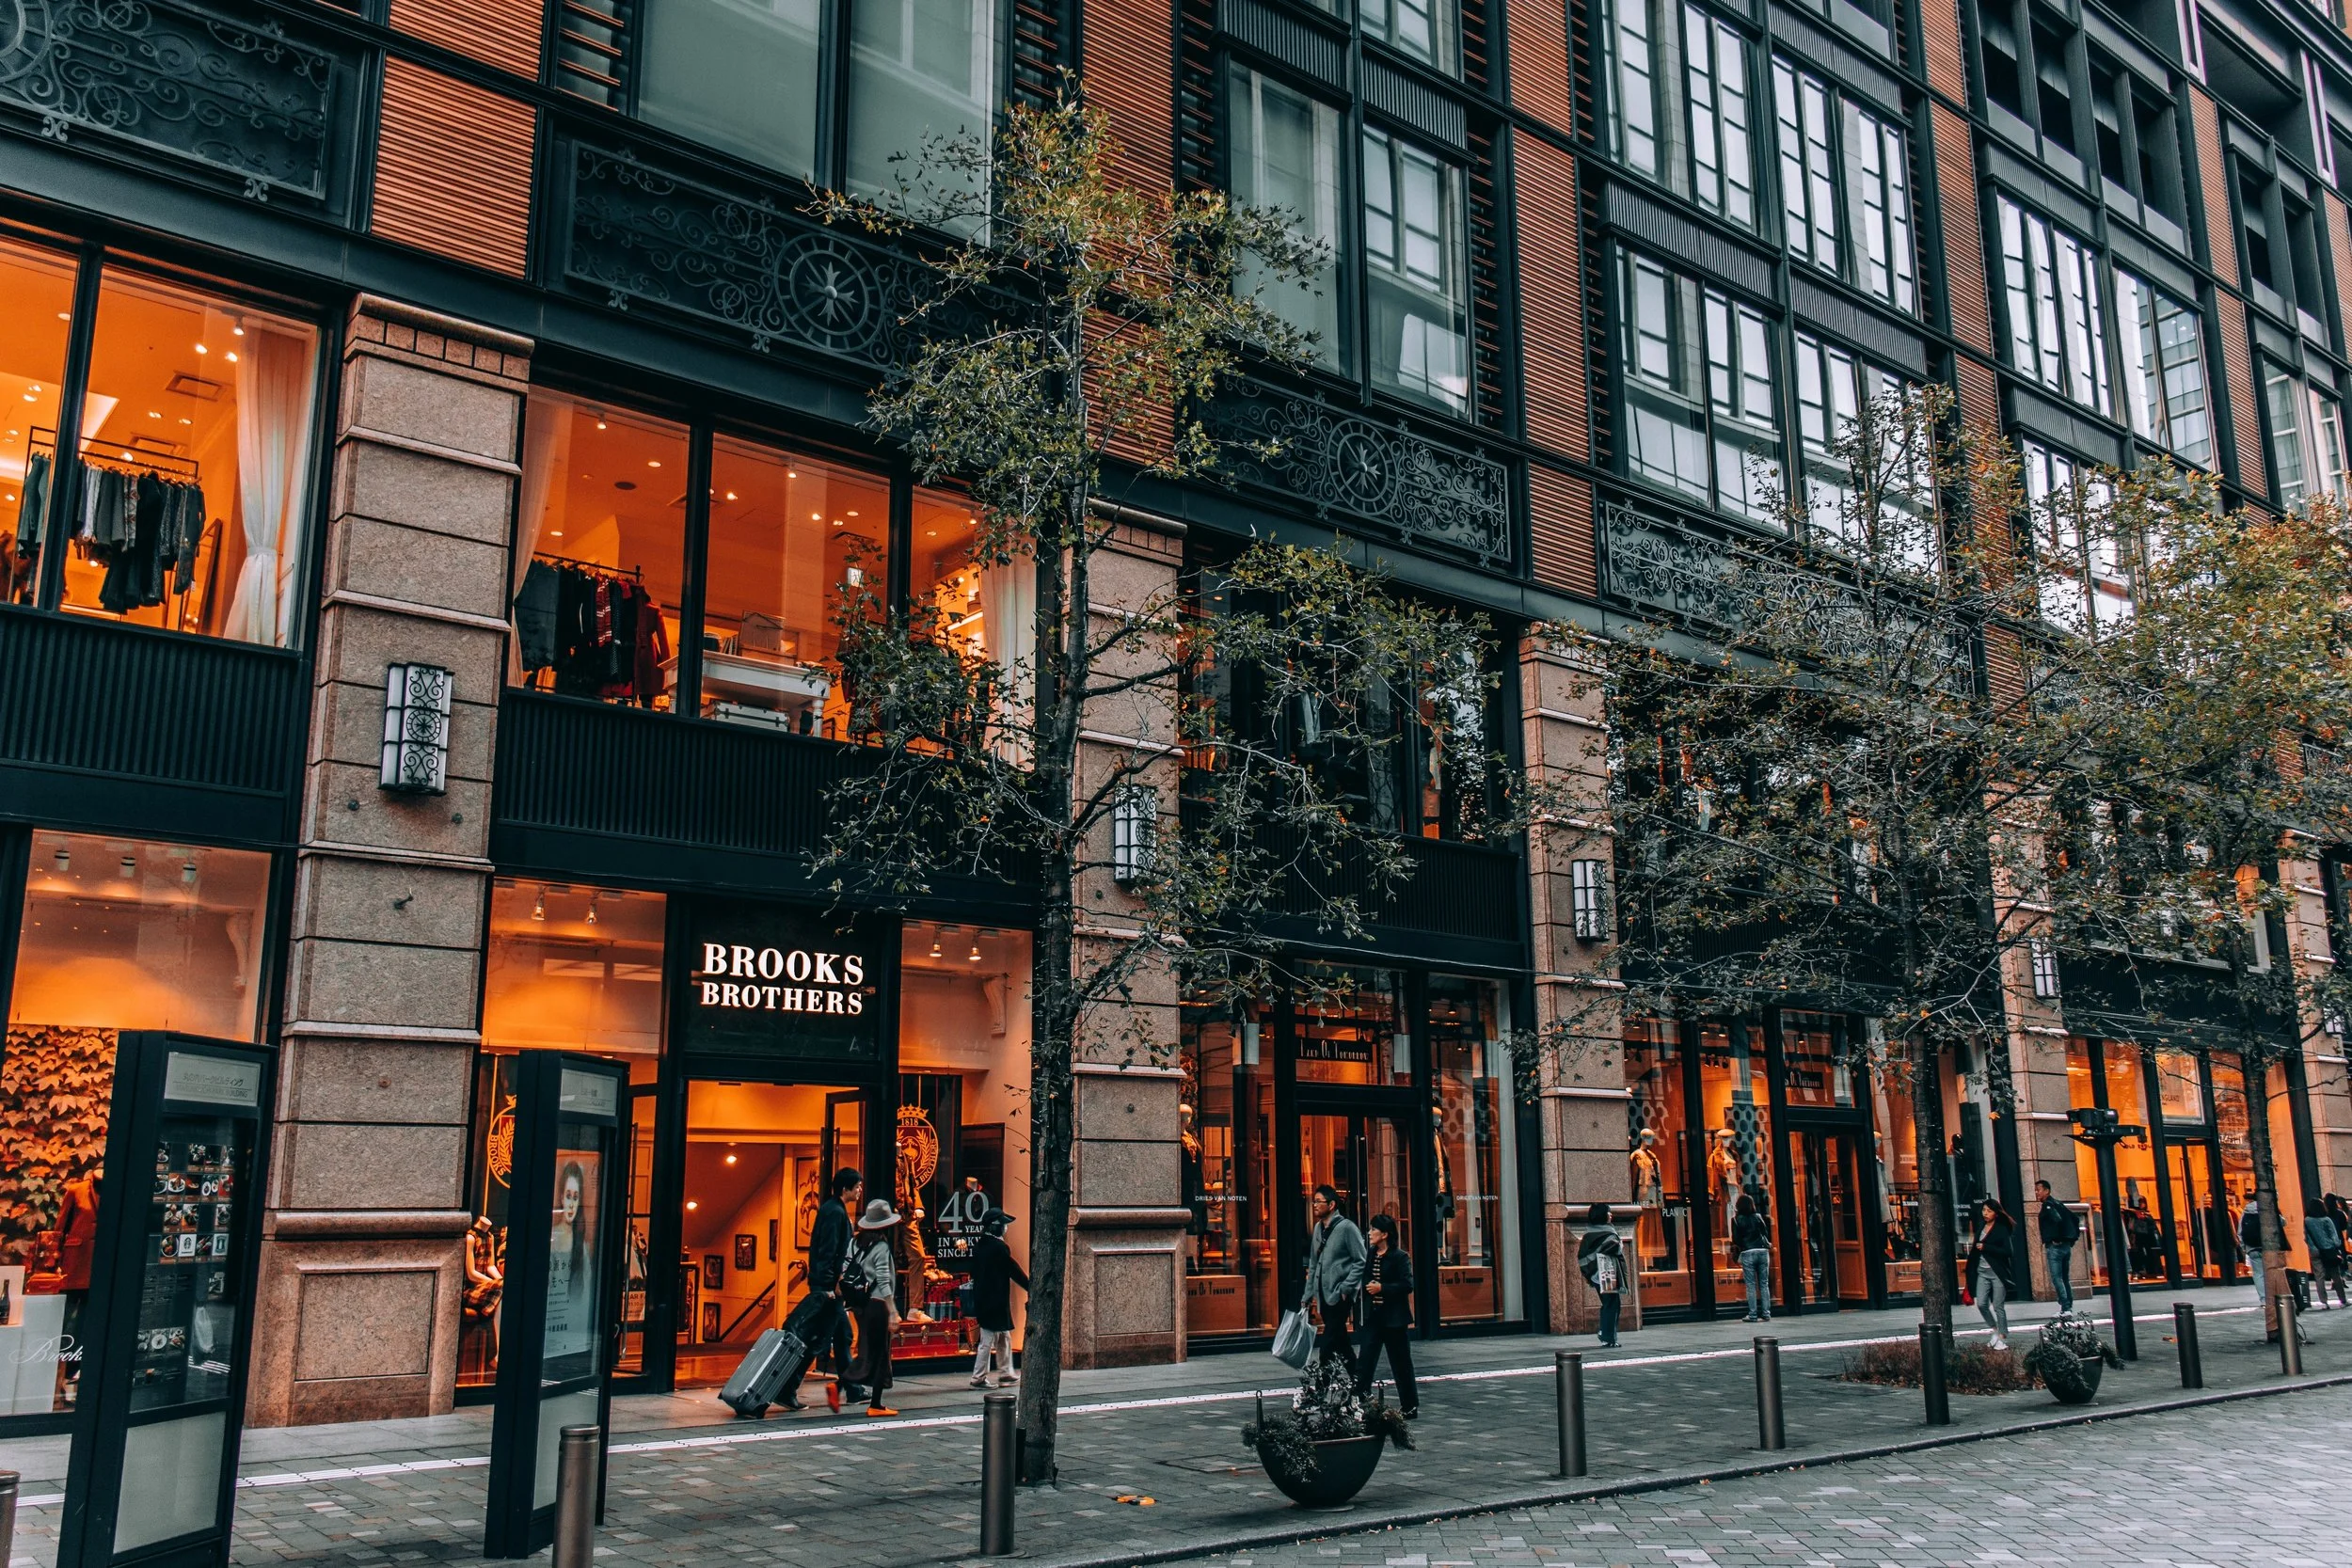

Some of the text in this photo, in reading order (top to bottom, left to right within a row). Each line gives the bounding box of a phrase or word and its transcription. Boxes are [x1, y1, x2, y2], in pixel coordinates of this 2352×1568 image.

[703, 942, 864, 986] BROOKS
[701, 981, 863, 1015] BROTHERS
[489, 1134, 506, 1176] BROOKS
[938, 1191, 989, 1233] 40
[937, 1238, 950, 1247] IN
[938, 1249, 966, 1258] SINCE
[8, 1334, 83, 1364] Brook
